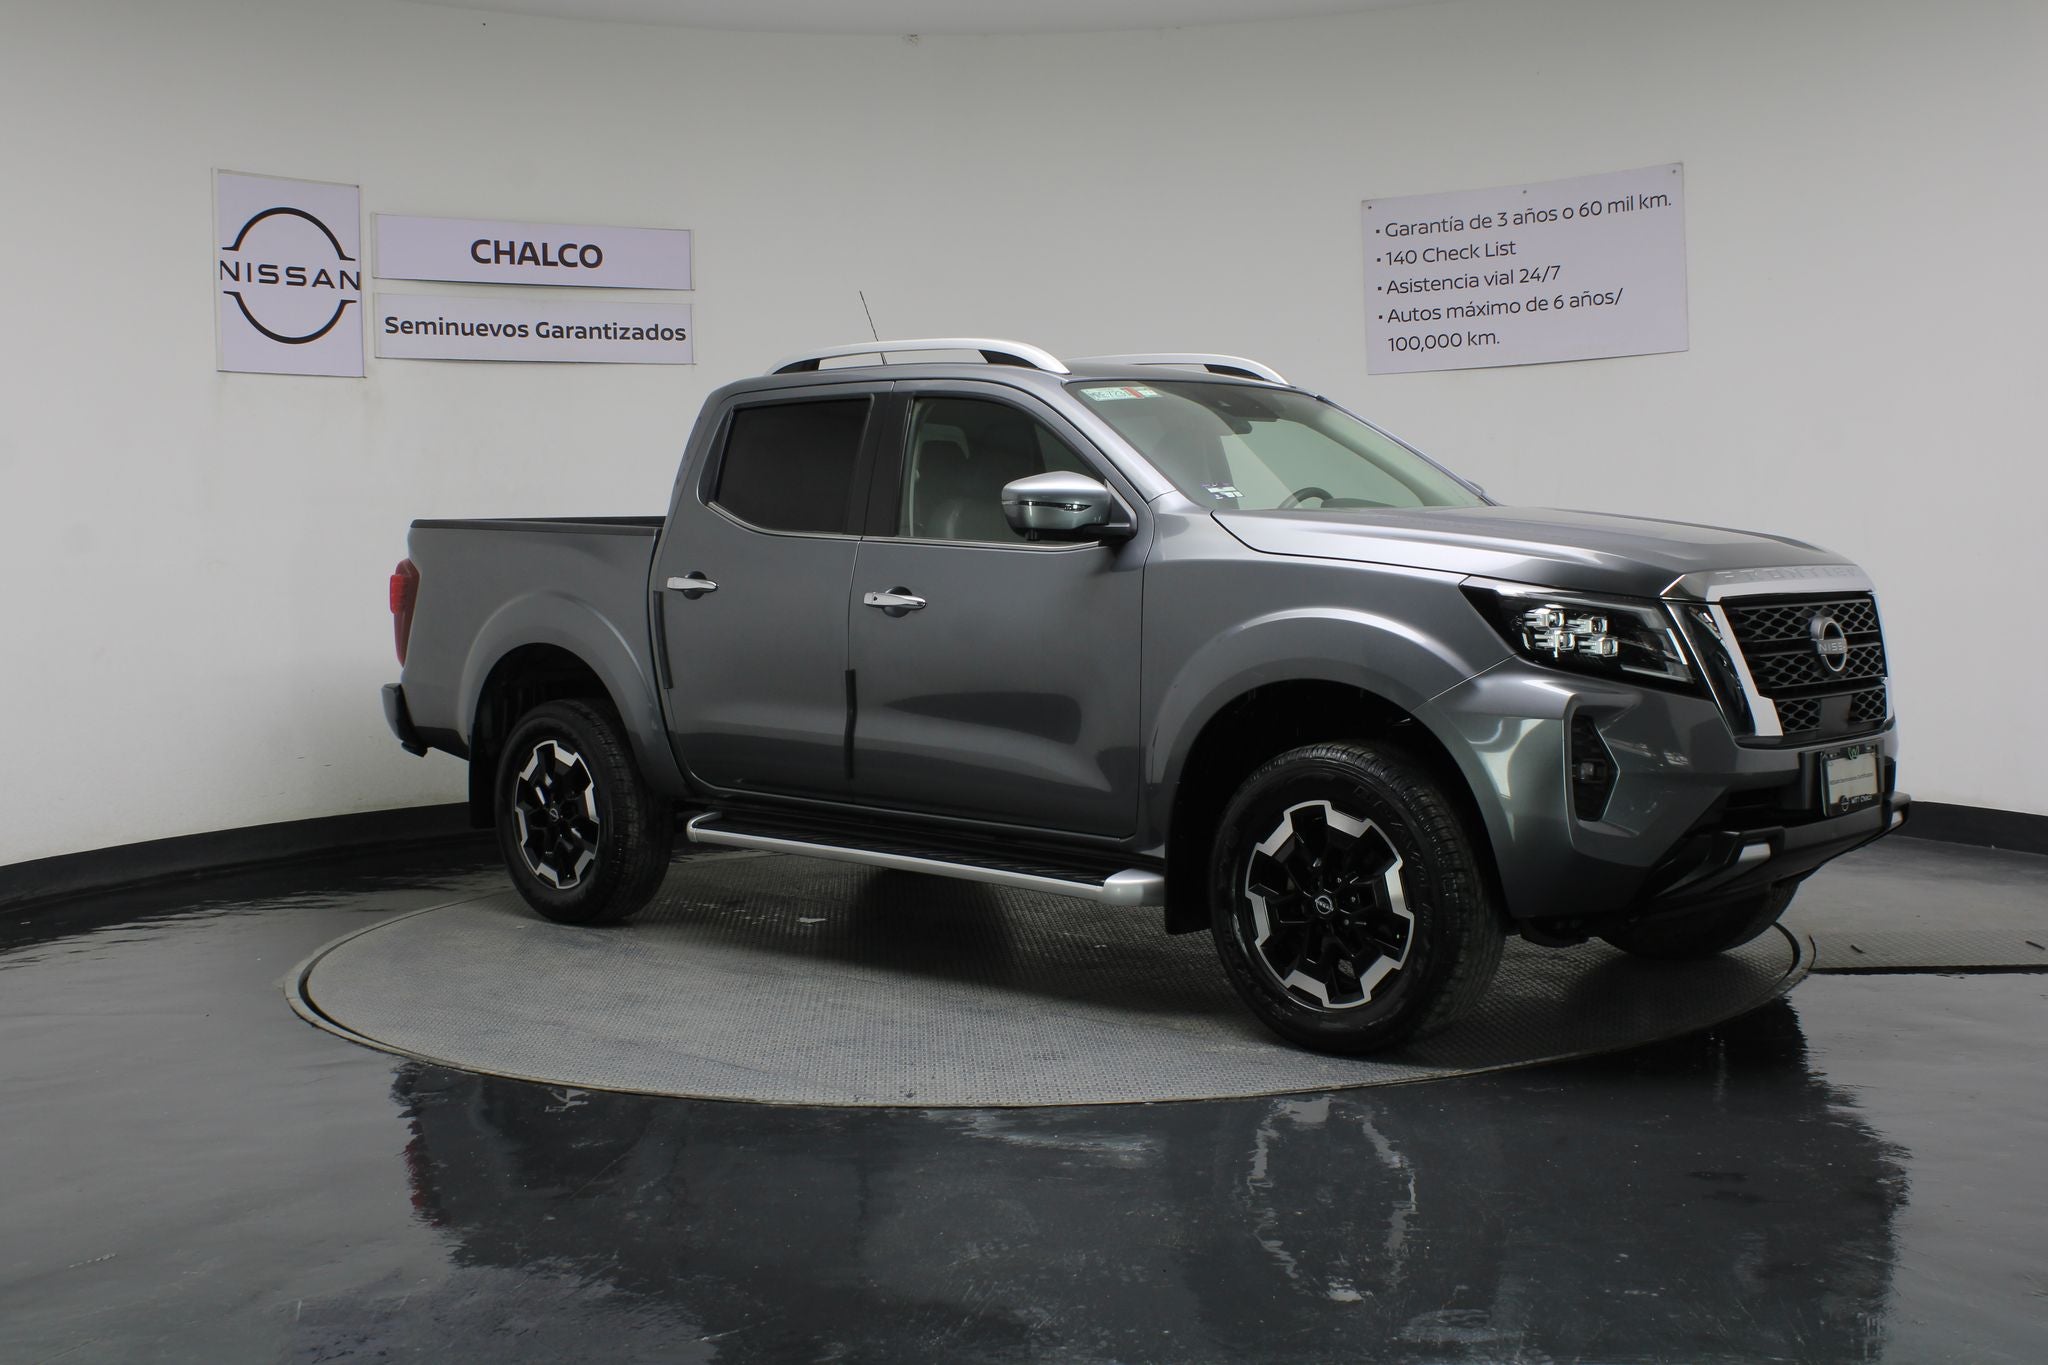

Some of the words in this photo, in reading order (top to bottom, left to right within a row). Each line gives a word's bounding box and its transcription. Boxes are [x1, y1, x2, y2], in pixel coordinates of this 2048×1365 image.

[1385, 216, 1464, 238] Garantía
[1470, 214, 1492, 230] de
[1497, 212, 1508, 227] 3
[1513, 207, 1558, 226] años
[1563, 206, 1574, 219] o
[1579, 201, 1602, 217] 60
[1608, 195, 1634, 214] mil
[1639, 193, 1672, 210] km.
[471, 239, 604, 269] CHALCO
[1386, 250, 1417, 266] 140
[1423, 243, 1480, 263] Check
[1486, 240, 1517, 257] List
[219, 260, 360, 290] NISSAN
[1387, 274, 1480, 295] Asistencia
[1484, 269, 1514, 286] vial
[1520, 265, 1561, 284] 24/7
[1387, 308, 1442, 324] Autos
[1447, 301, 1521, 320] máximo
[1526, 296, 1549, 313] de
[1554, 294, 1564, 310] 6
[1570, 288, 1624, 309] años/
[385, 316, 530, 339] Seminuevos
[536, 321, 687, 342] Garantizados
[1388, 333, 1462, 352] 100,000
[1468, 331, 1500, 347] km.
